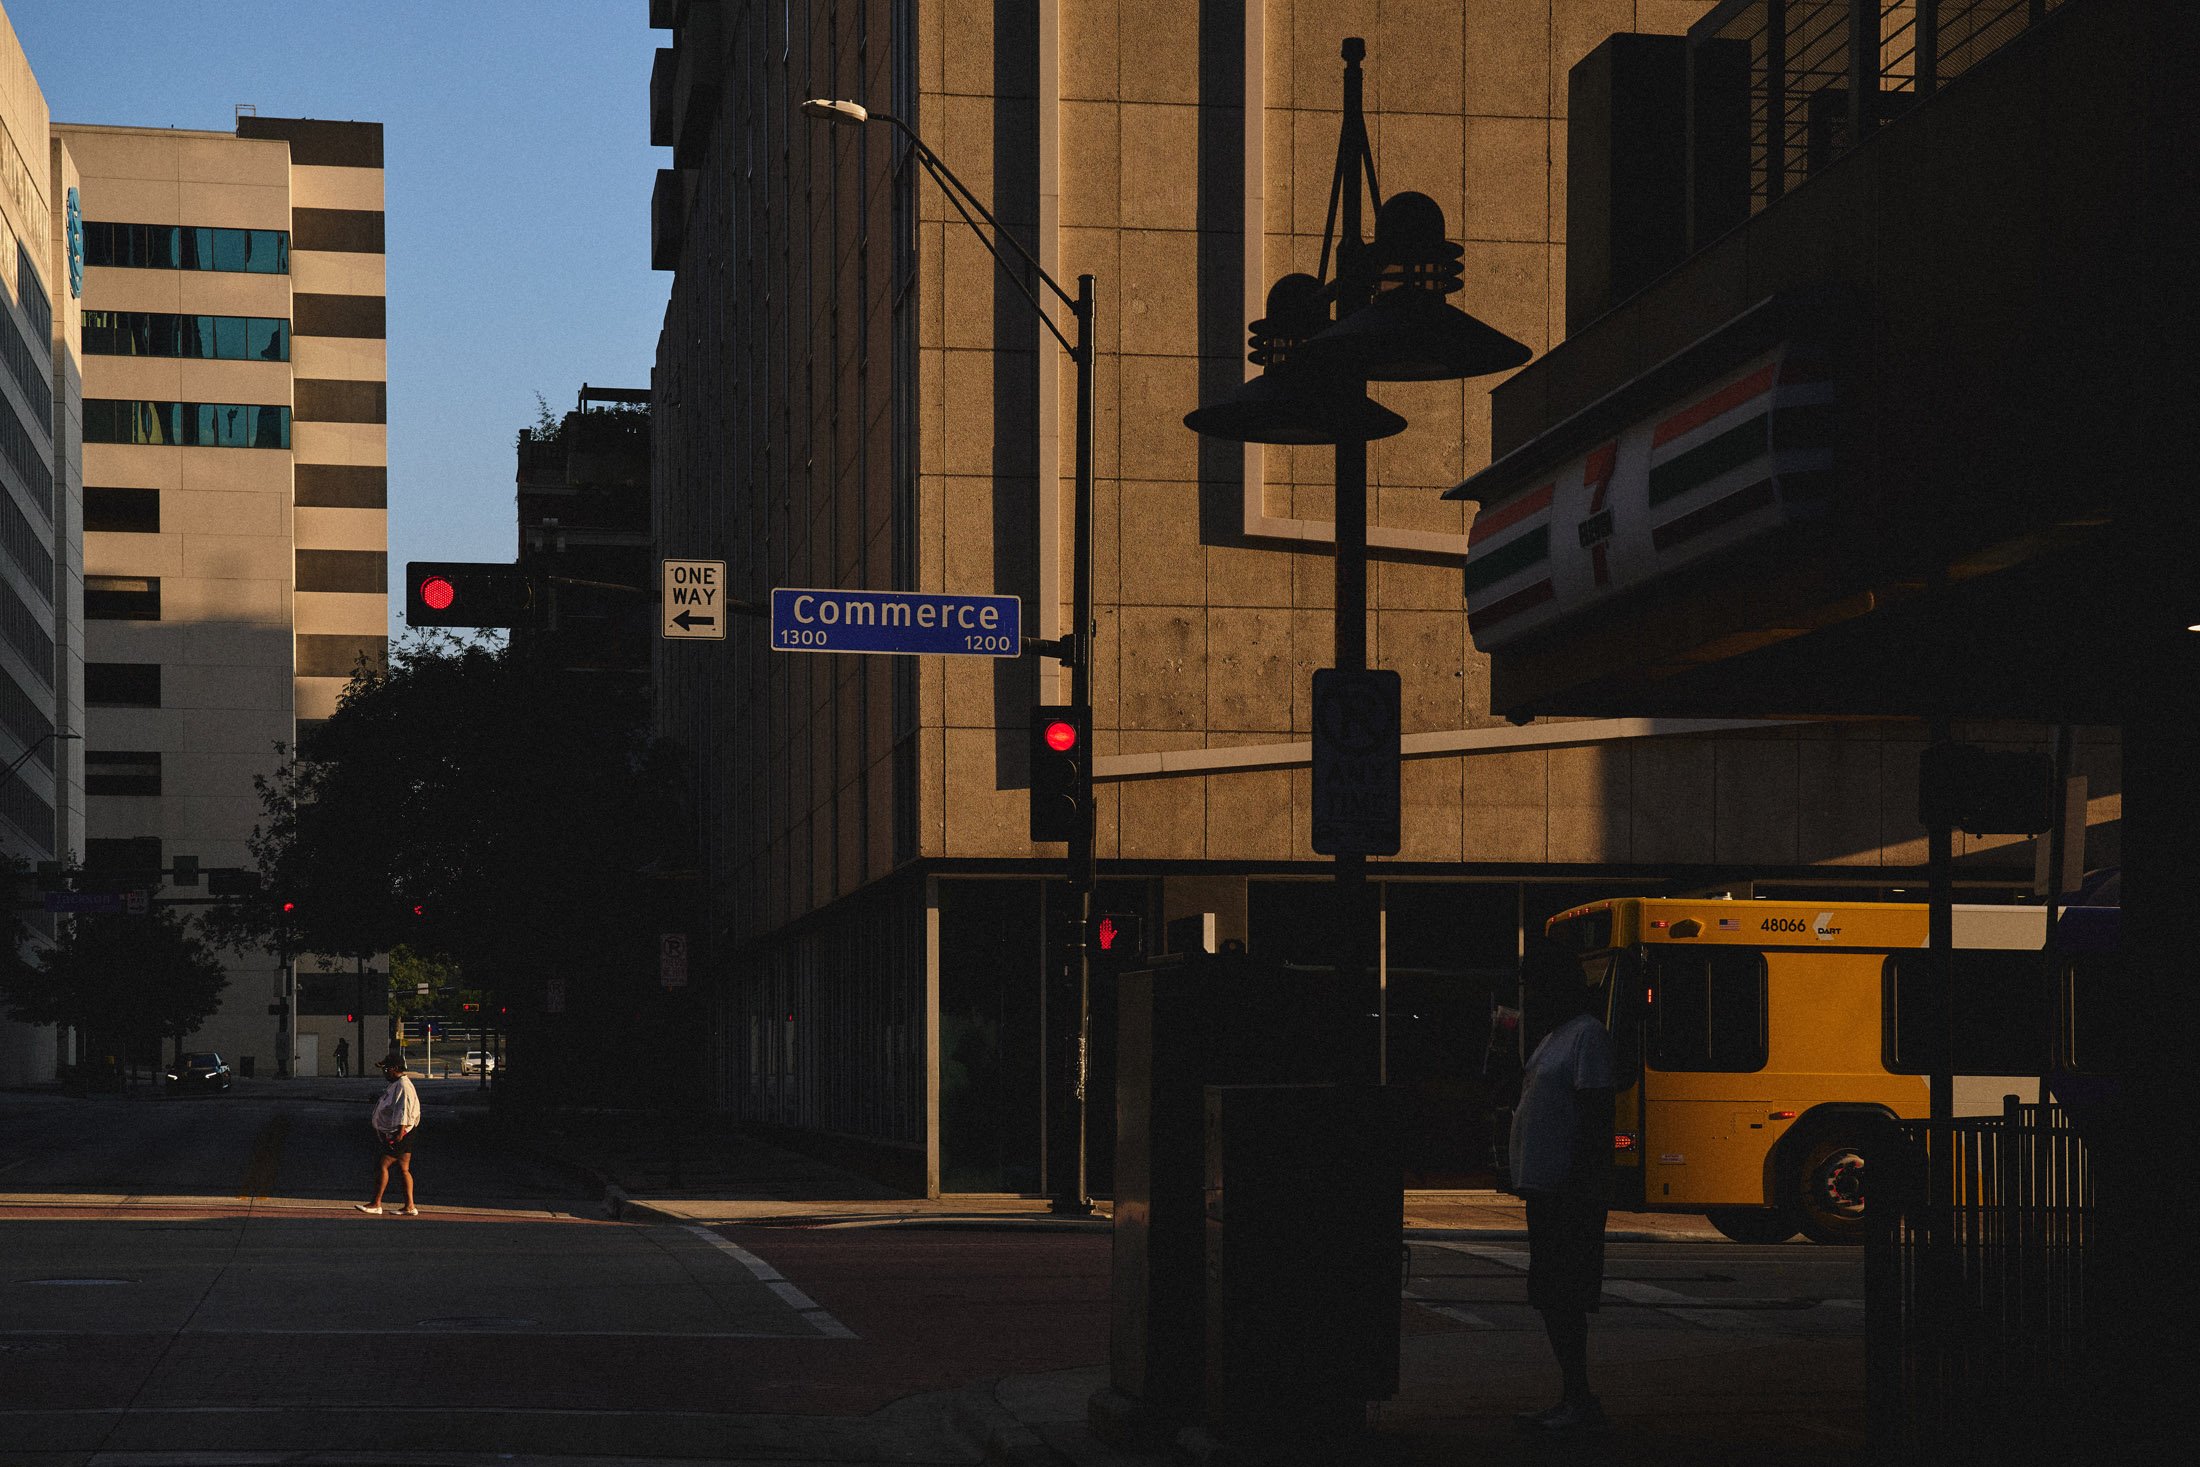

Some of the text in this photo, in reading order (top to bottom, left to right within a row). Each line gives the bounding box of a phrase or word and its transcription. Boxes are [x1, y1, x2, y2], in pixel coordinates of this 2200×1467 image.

[1583, 439, 1618, 587] 7
[674, 566, 715, 585] ONE
[672, 587, 716, 606] WAY
[793, 594, 999, 630] Commerce
[780, 629, 1011, 652] 1300 1200
[1760, 918, 1841, 935] 48066 DART
